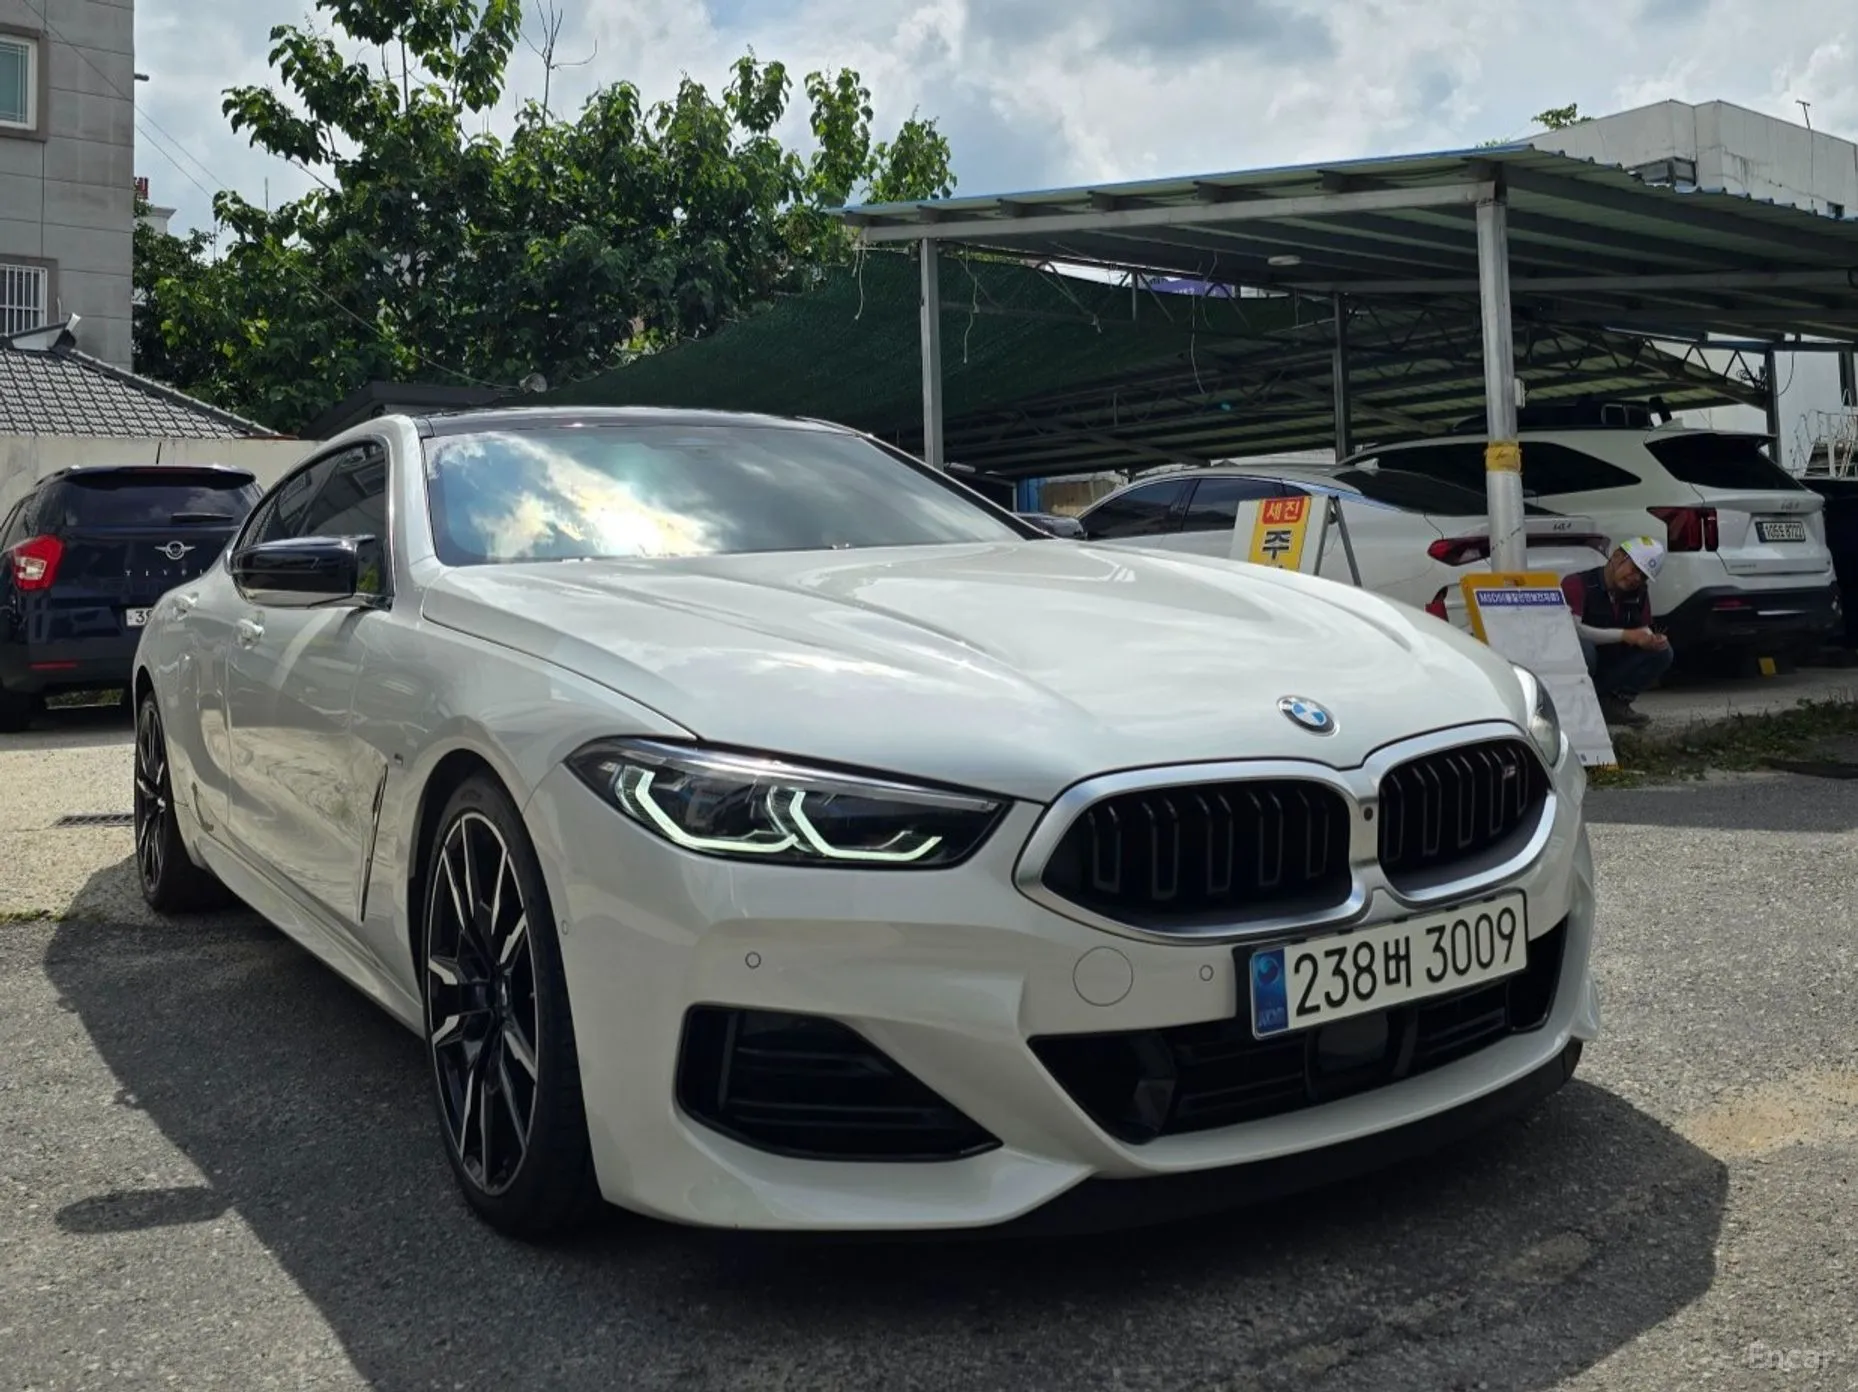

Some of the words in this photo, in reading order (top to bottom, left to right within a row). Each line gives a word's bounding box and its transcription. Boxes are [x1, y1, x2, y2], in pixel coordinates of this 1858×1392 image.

[1262, 530, 1292, 569] 주
[1293, 935, 1412, 1017] 238버
[1425, 906, 1517, 983] 3009
